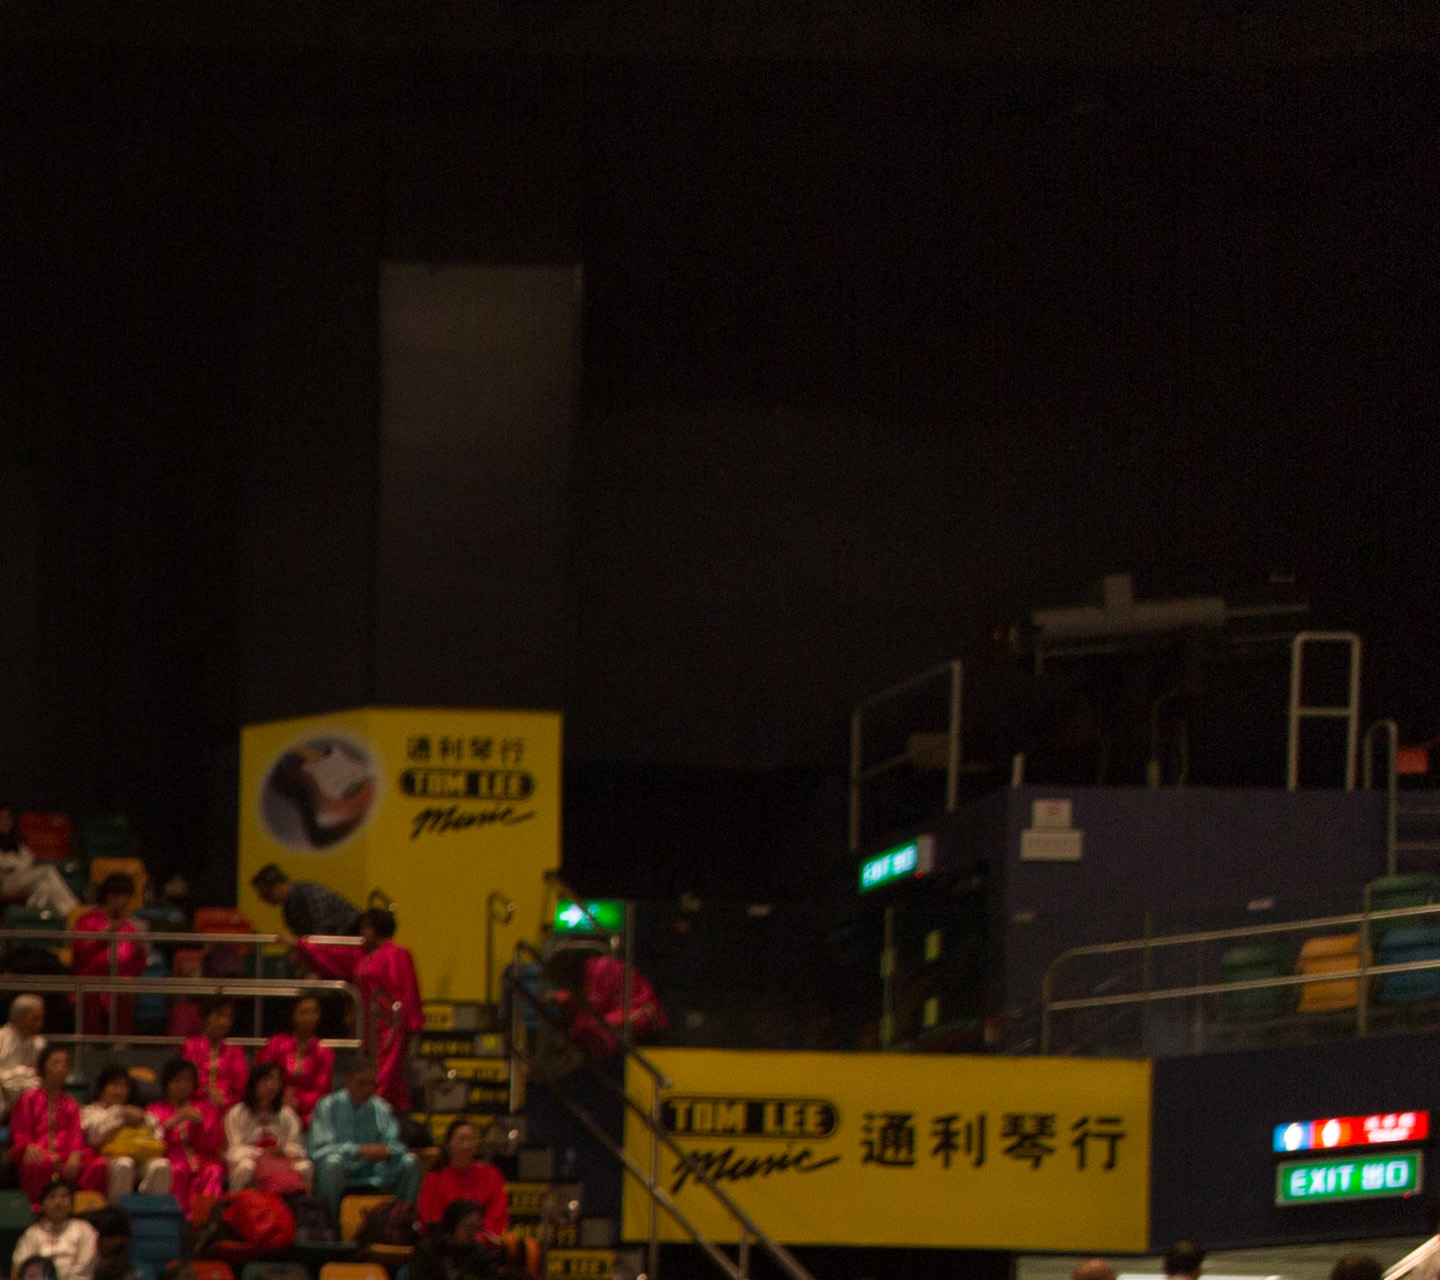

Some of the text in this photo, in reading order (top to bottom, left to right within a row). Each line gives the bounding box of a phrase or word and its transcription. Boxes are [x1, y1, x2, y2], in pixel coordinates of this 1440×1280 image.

[407, 734, 525, 764] 通利琴行
[410, 803, 536, 839] Music
[670, 1101, 829, 1135] TOM LEE
[860, 1111, 1126, 1171] 通利琴行
[672, 1142, 842, 1194] Music
[1289, 1163, 1356, 1197] EXIT
[1361, 1160, 1410, 1191] 出口
